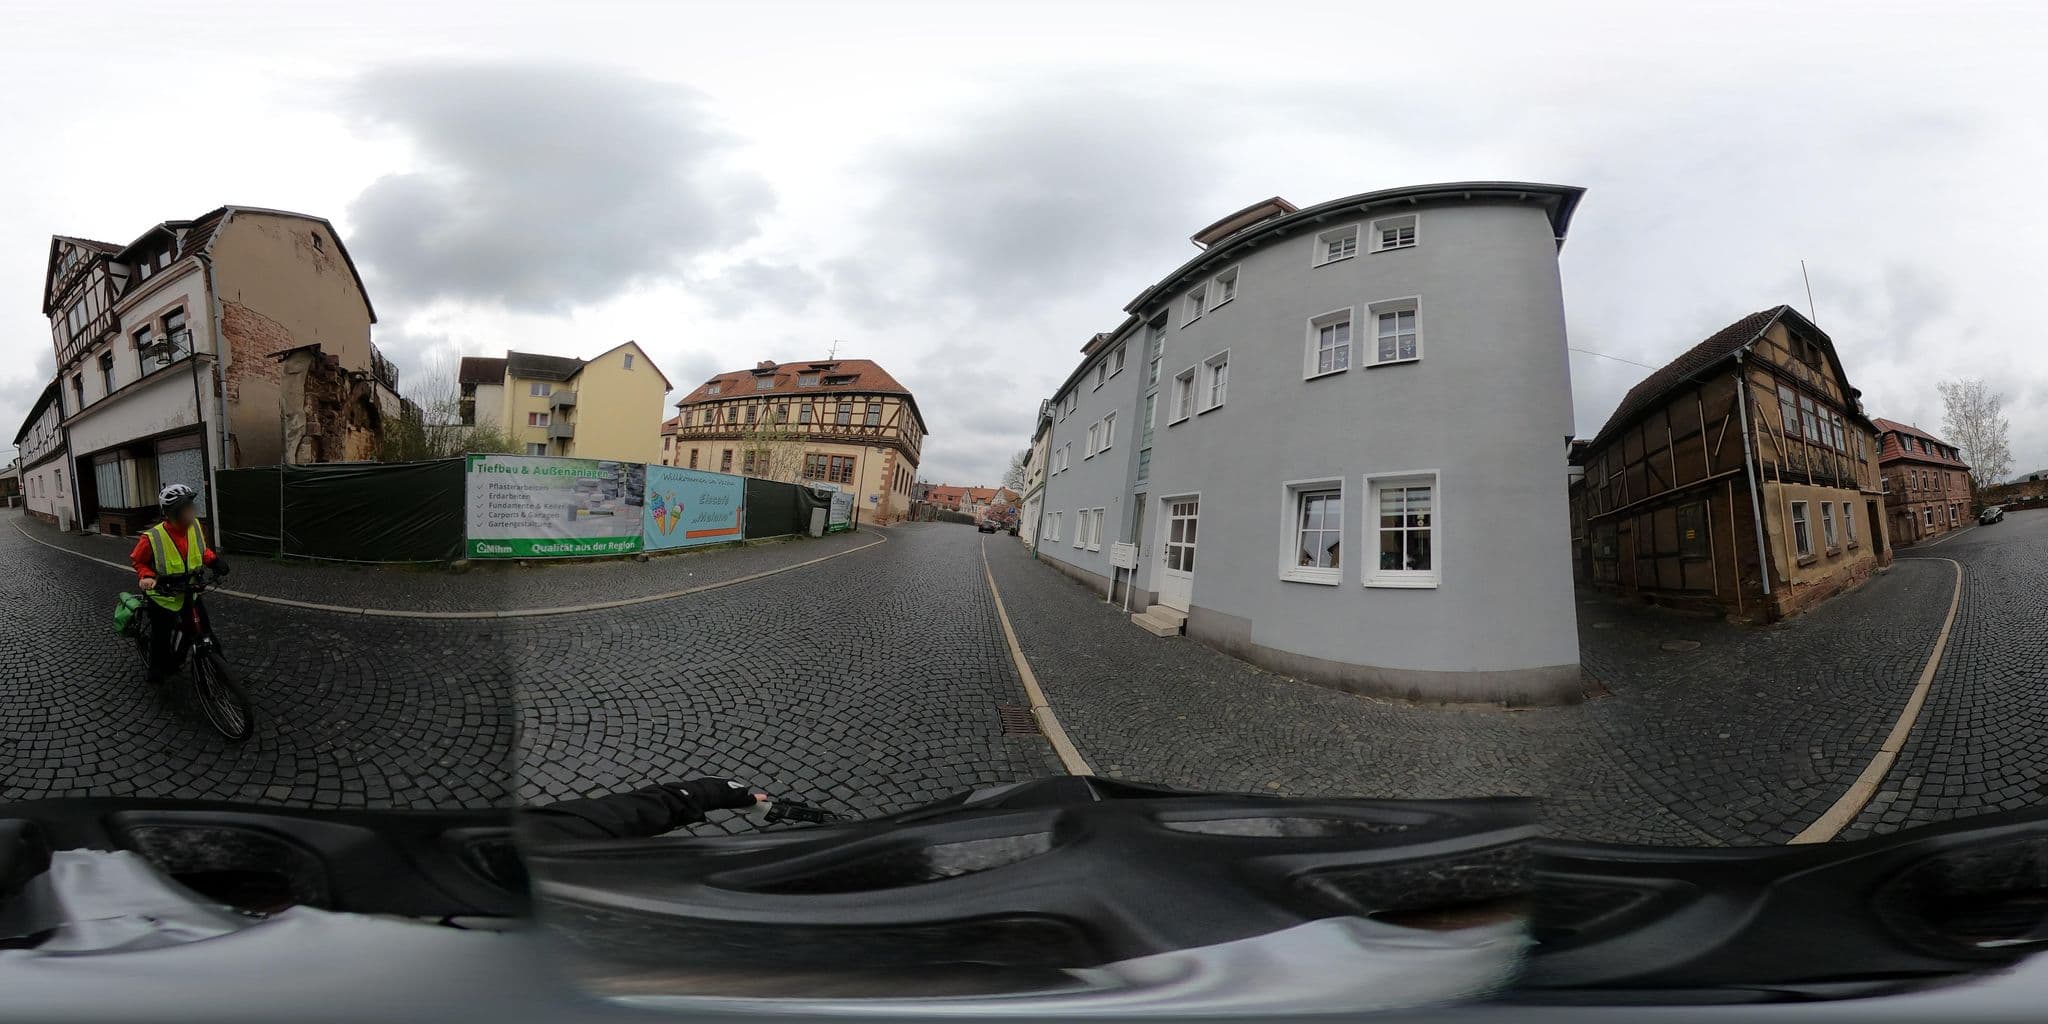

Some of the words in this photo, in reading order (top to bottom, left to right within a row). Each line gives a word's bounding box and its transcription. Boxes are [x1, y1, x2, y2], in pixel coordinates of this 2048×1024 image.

[478, 464, 518, 475] Tiefbau
[521, 465, 529, 475] &
[533, 466, 609, 479] Außenanlagen
[489, 483, 549, 491] Pflasterarbeiten
[488, 511, 519, 519] Carports
[532, 543, 574, 554] Qualität
[575, 543, 592, 552] aus
[593, 542, 606, 551] der
[608, 541, 635, 552] Region
